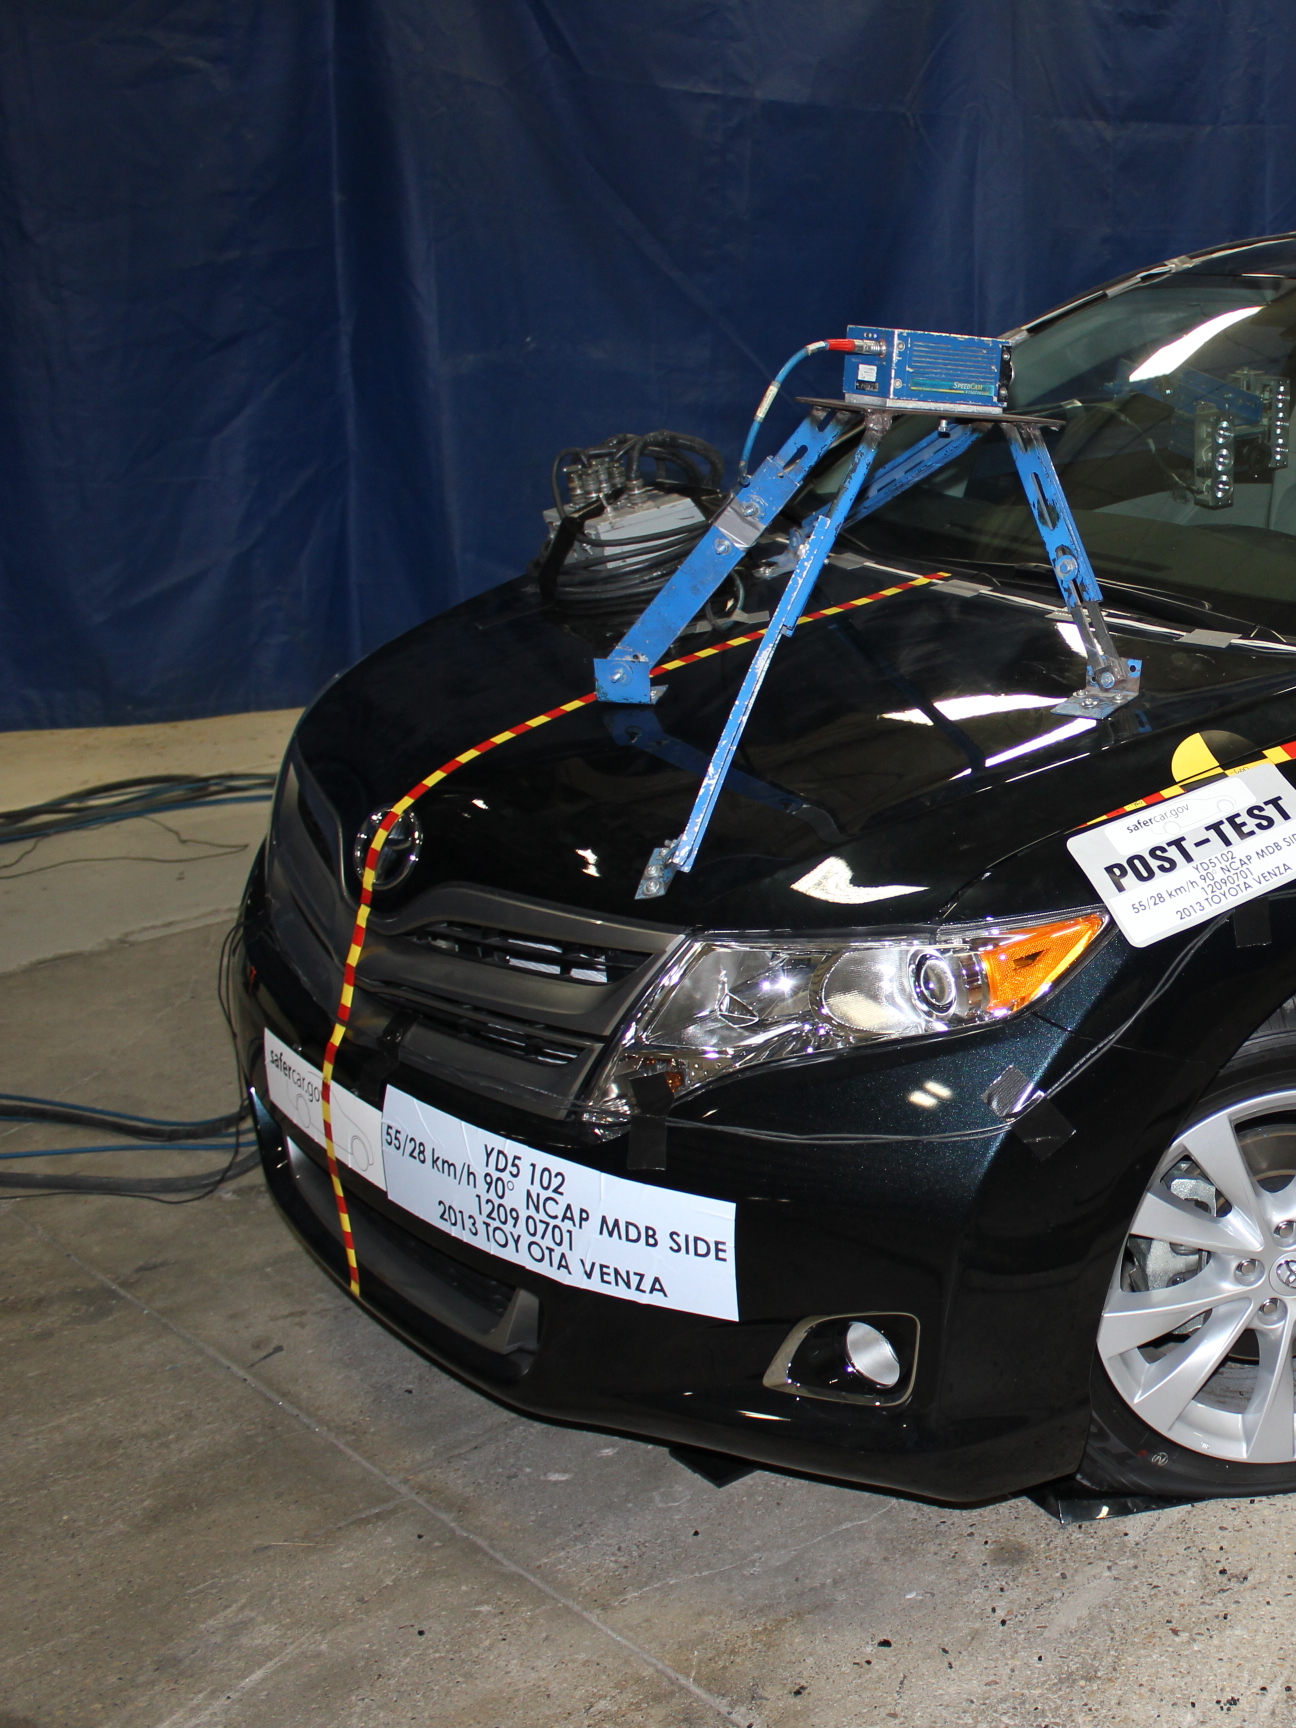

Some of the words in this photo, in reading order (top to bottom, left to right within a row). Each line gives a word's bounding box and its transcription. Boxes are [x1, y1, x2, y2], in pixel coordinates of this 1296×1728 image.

[1104, 795, 1292, 893] POST-TEST
[1126, 803, 1189, 834] safercar.gov
[1131, 893, 1166, 914] 55/28
[1166, 880, 1199, 903] km/h
[1220, 854, 1253, 876] NCAP
[1255, 841, 1283, 860] MDB
[1176, 901, 1205, 921] 2013
[1204, 882, 1253, 908] TOYOTA
[1254, 862, 1293, 886] VENZA
[1192, 850, 1237, 875] YD5102
[1201, 867, 1255, 896] 12090701
[270, 1049, 321, 1103] safercar.go
[385, 1125, 426, 1164] 55/28
[432, 1148, 477, 1189] km/h
[484, 1172, 515, 1200] 90°
[526, 1188, 590, 1229] NCAP
[599, 1215, 658, 1248] MDB
[669, 1231, 728, 1262] SIDE
[438, 1200, 478, 1236] 2013
[580, 1257, 669, 1298] VENZA
